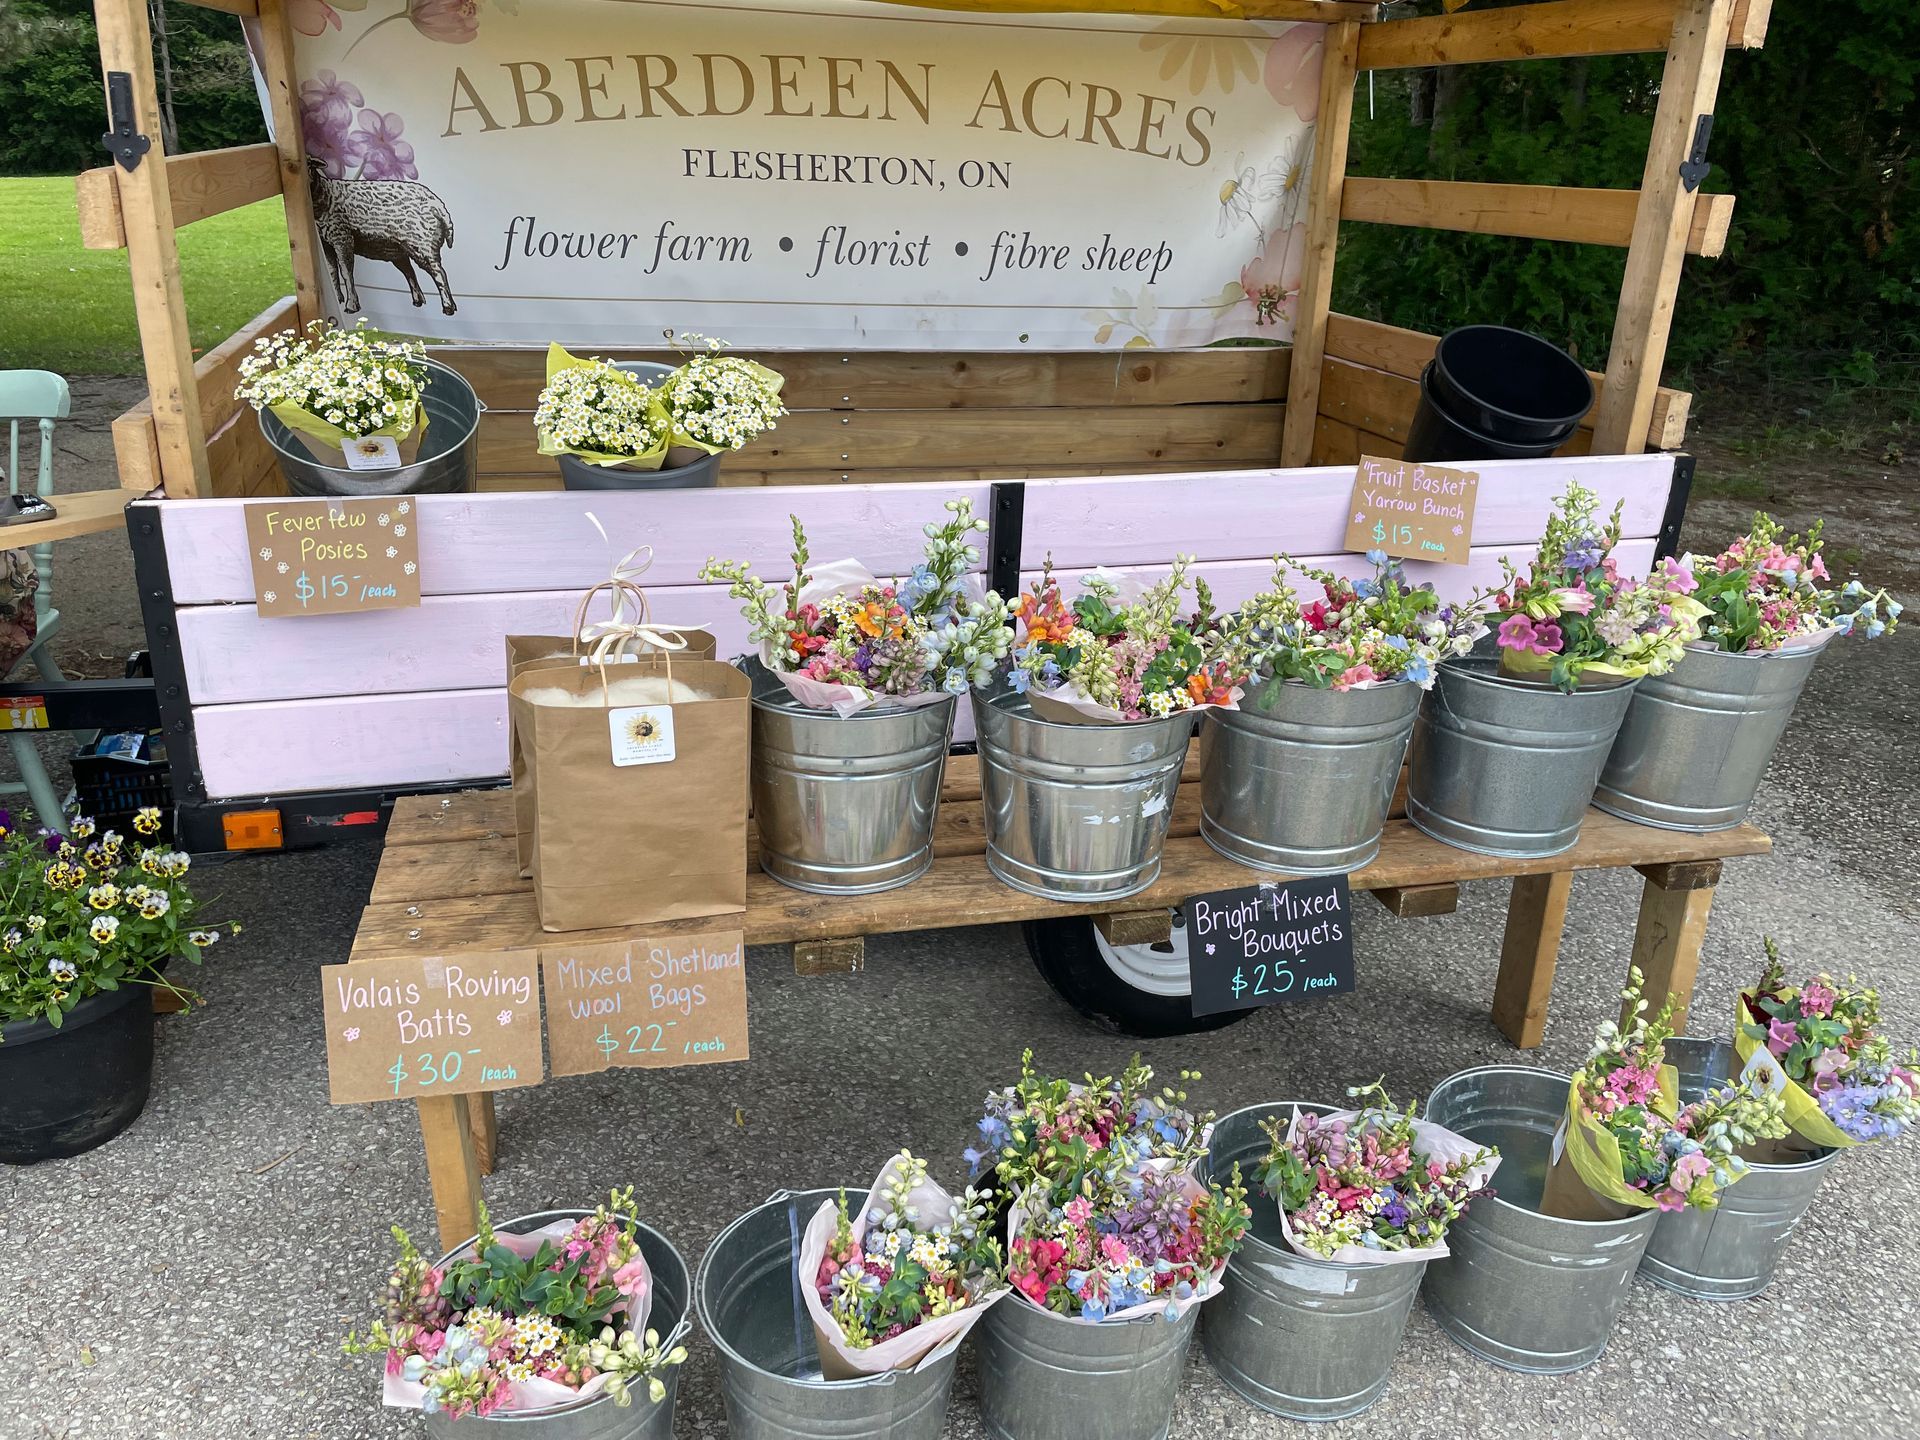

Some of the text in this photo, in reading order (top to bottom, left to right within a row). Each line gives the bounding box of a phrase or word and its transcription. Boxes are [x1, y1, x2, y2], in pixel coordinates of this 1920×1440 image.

[440, 52, 1216, 168] ABERDEEN ACRES
[682, 148, 1013, 192] FLESHERTON, ON
[494, 216, 1174, 285] flower farm florist fibre sheep
[1364, 461, 1406, 488] "Fruit
[1363, 489, 1465, 520] Yarrow Bunch
[300, 537, 368, 562] Posies
[1420, 540, 1445, 552] /each
[360, 584, 398, 602] /each
[1195, 888, 1341, 940] Bright Mixed
[1243, 920, 1343, 958] Bouquets
[557, 943, 742, 990] Mixed Shetland
[1303, 973, 1338, 991] /each
[336, 965, 531, 1013] Valais Roving
[649, 983, 708, 1016] Bags
[398, 1007, 473, 1044] Batts
[683, 1038, 726, 1055] /each
[480, 1065, 517, 1084] /each
